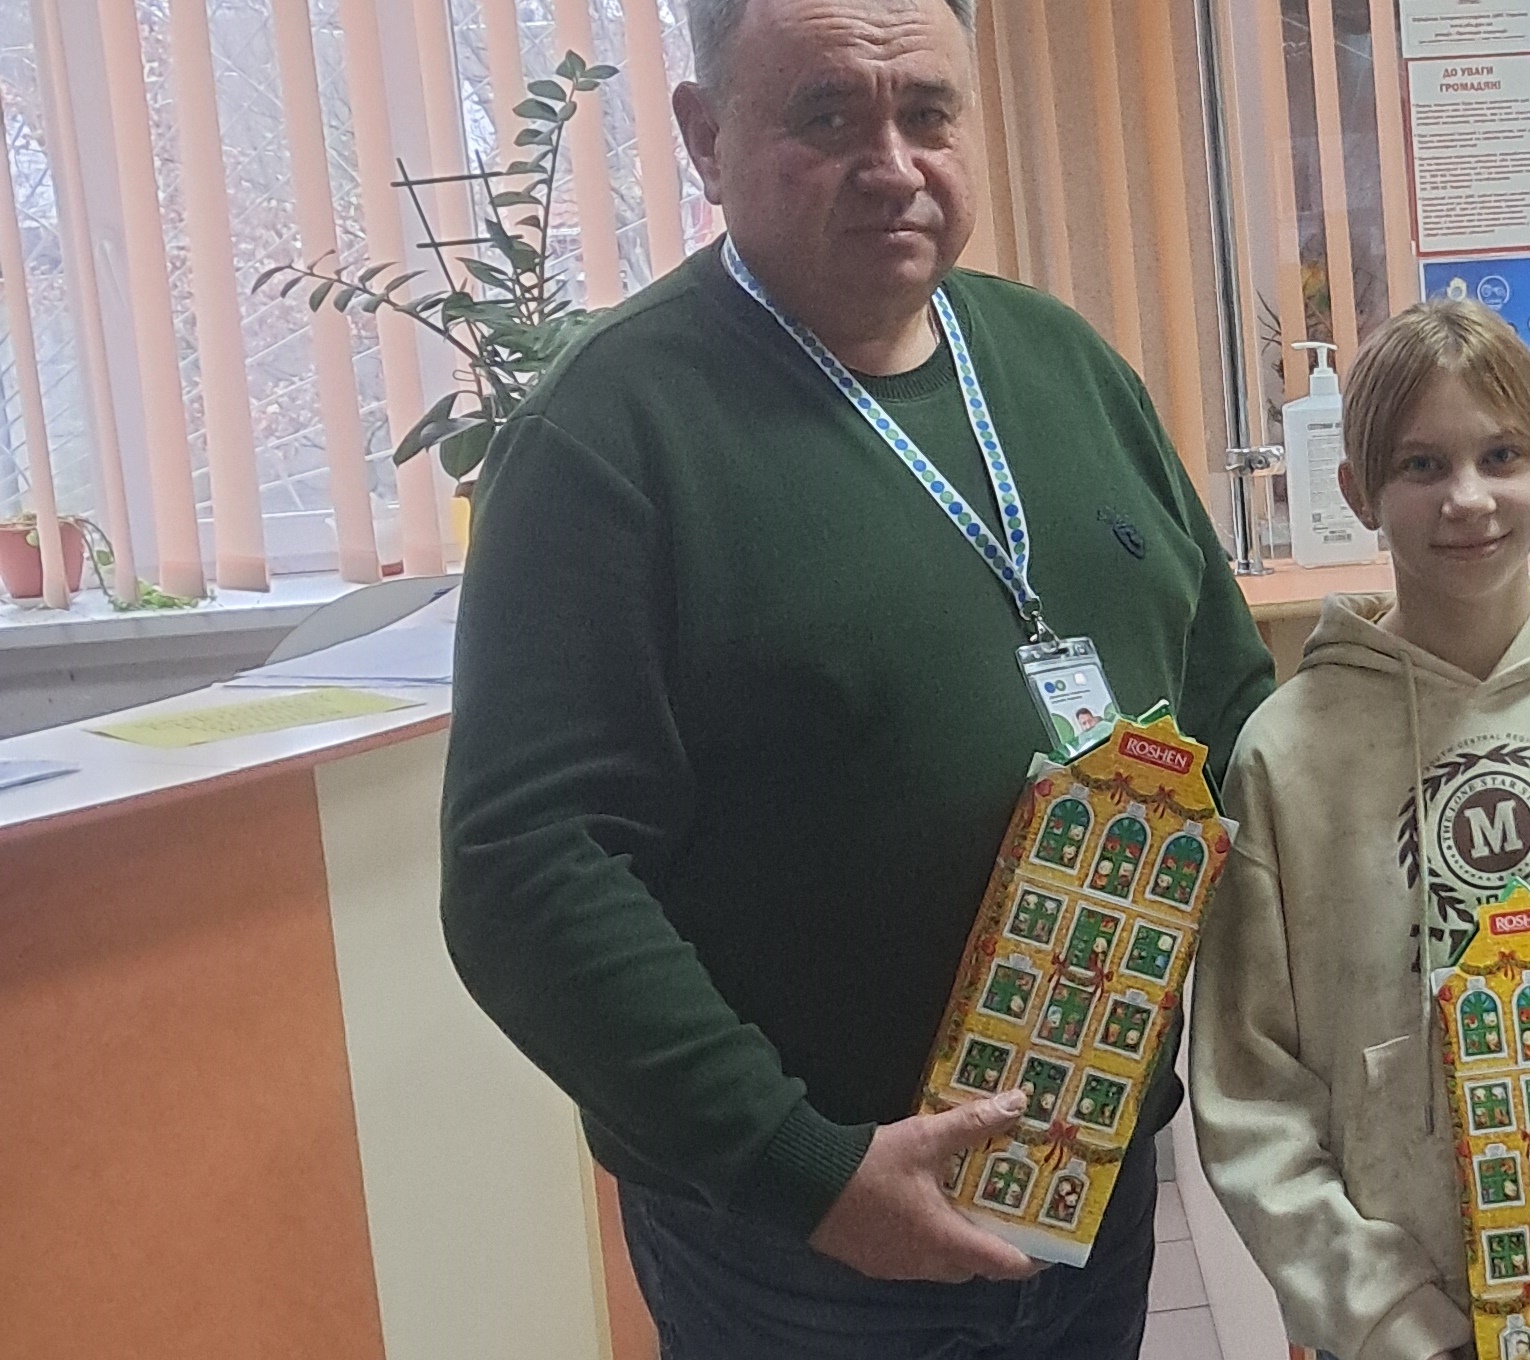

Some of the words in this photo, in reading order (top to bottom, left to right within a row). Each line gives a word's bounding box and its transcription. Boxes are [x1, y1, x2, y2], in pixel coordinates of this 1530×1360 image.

[1442, 67, 1458, 80] ДО
[1460, 65, 1494, 78] УВАГИ
[1125, 737, 1188, 769] ROSHEN
[1463, 799, 1524, 859] M
